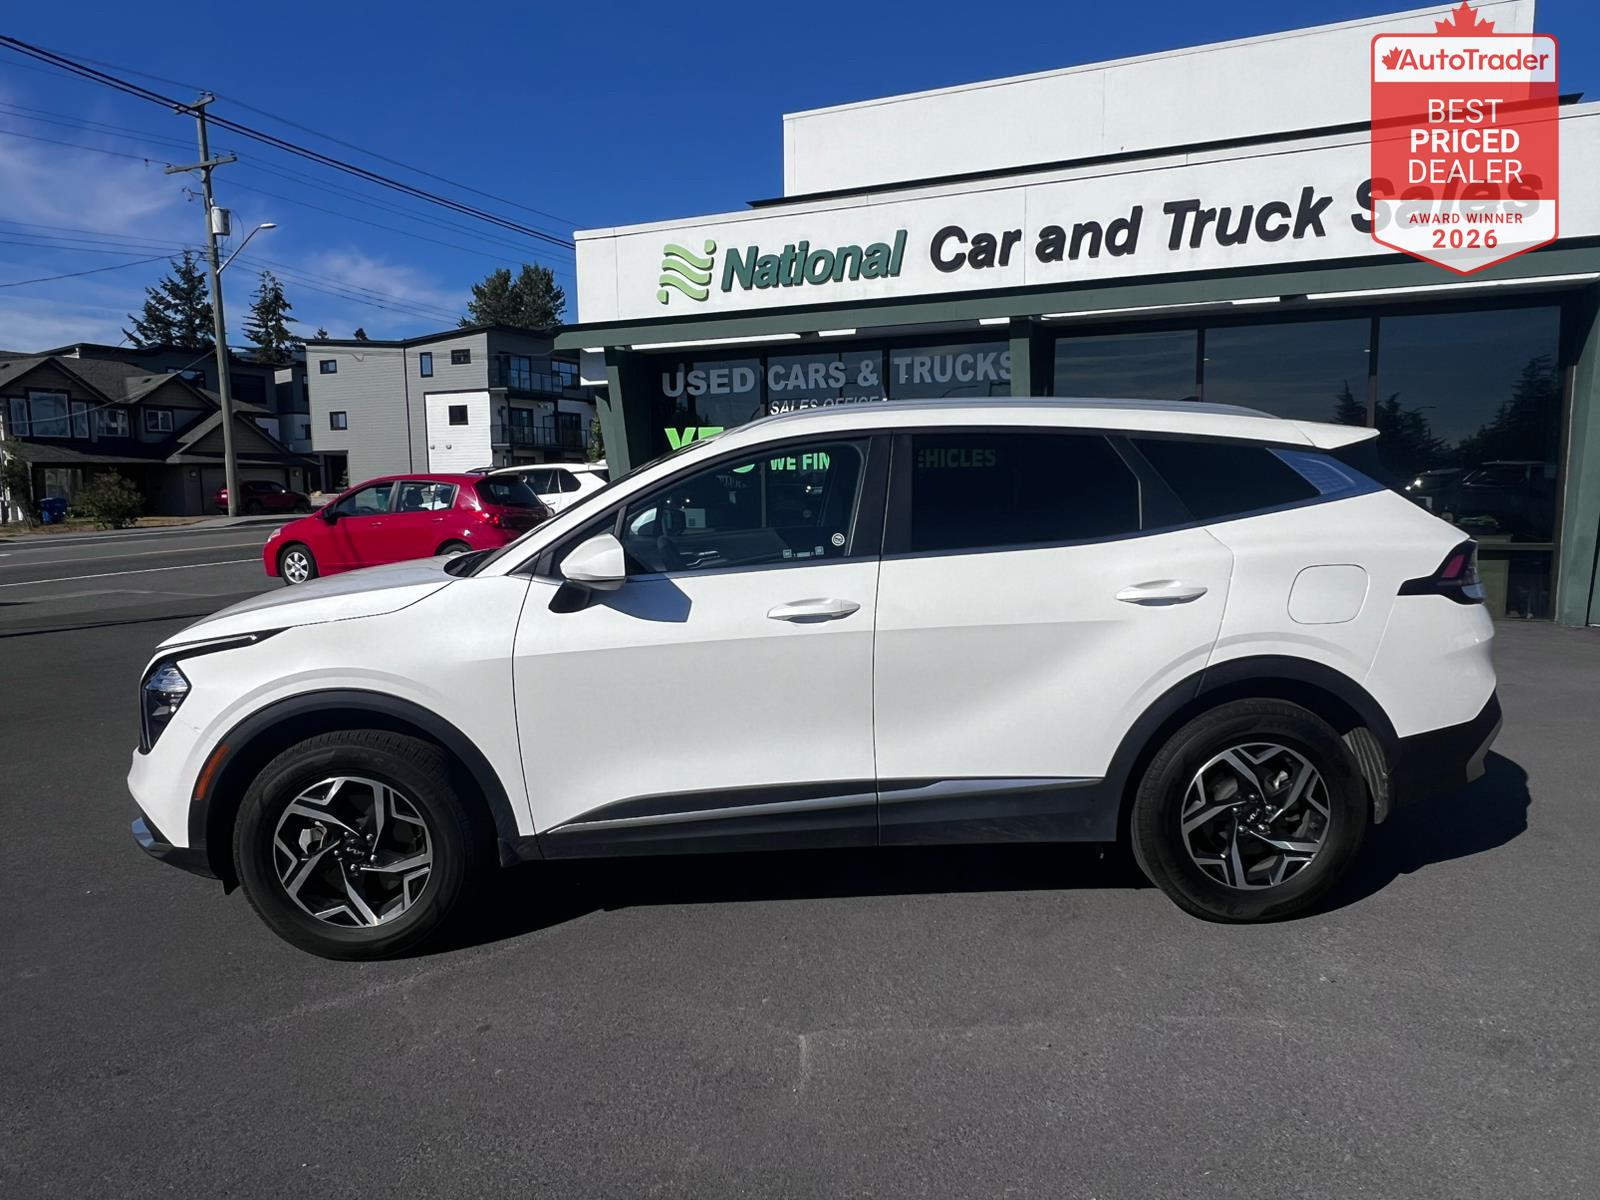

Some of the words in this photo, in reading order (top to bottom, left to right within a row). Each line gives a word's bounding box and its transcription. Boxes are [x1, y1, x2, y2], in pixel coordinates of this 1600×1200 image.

[720, 229, 908, 292] National
[929, 224, 1022, 273] Car
[1035, 204, 1144, 263] and
[1162, 185, 1333, 251] Truck
[1350, 168, 1544, 234] Sales
[662, 367, 755, 398] USED
[768, 361, 846, 391] CARS
[857, 359, 879, 387] &
